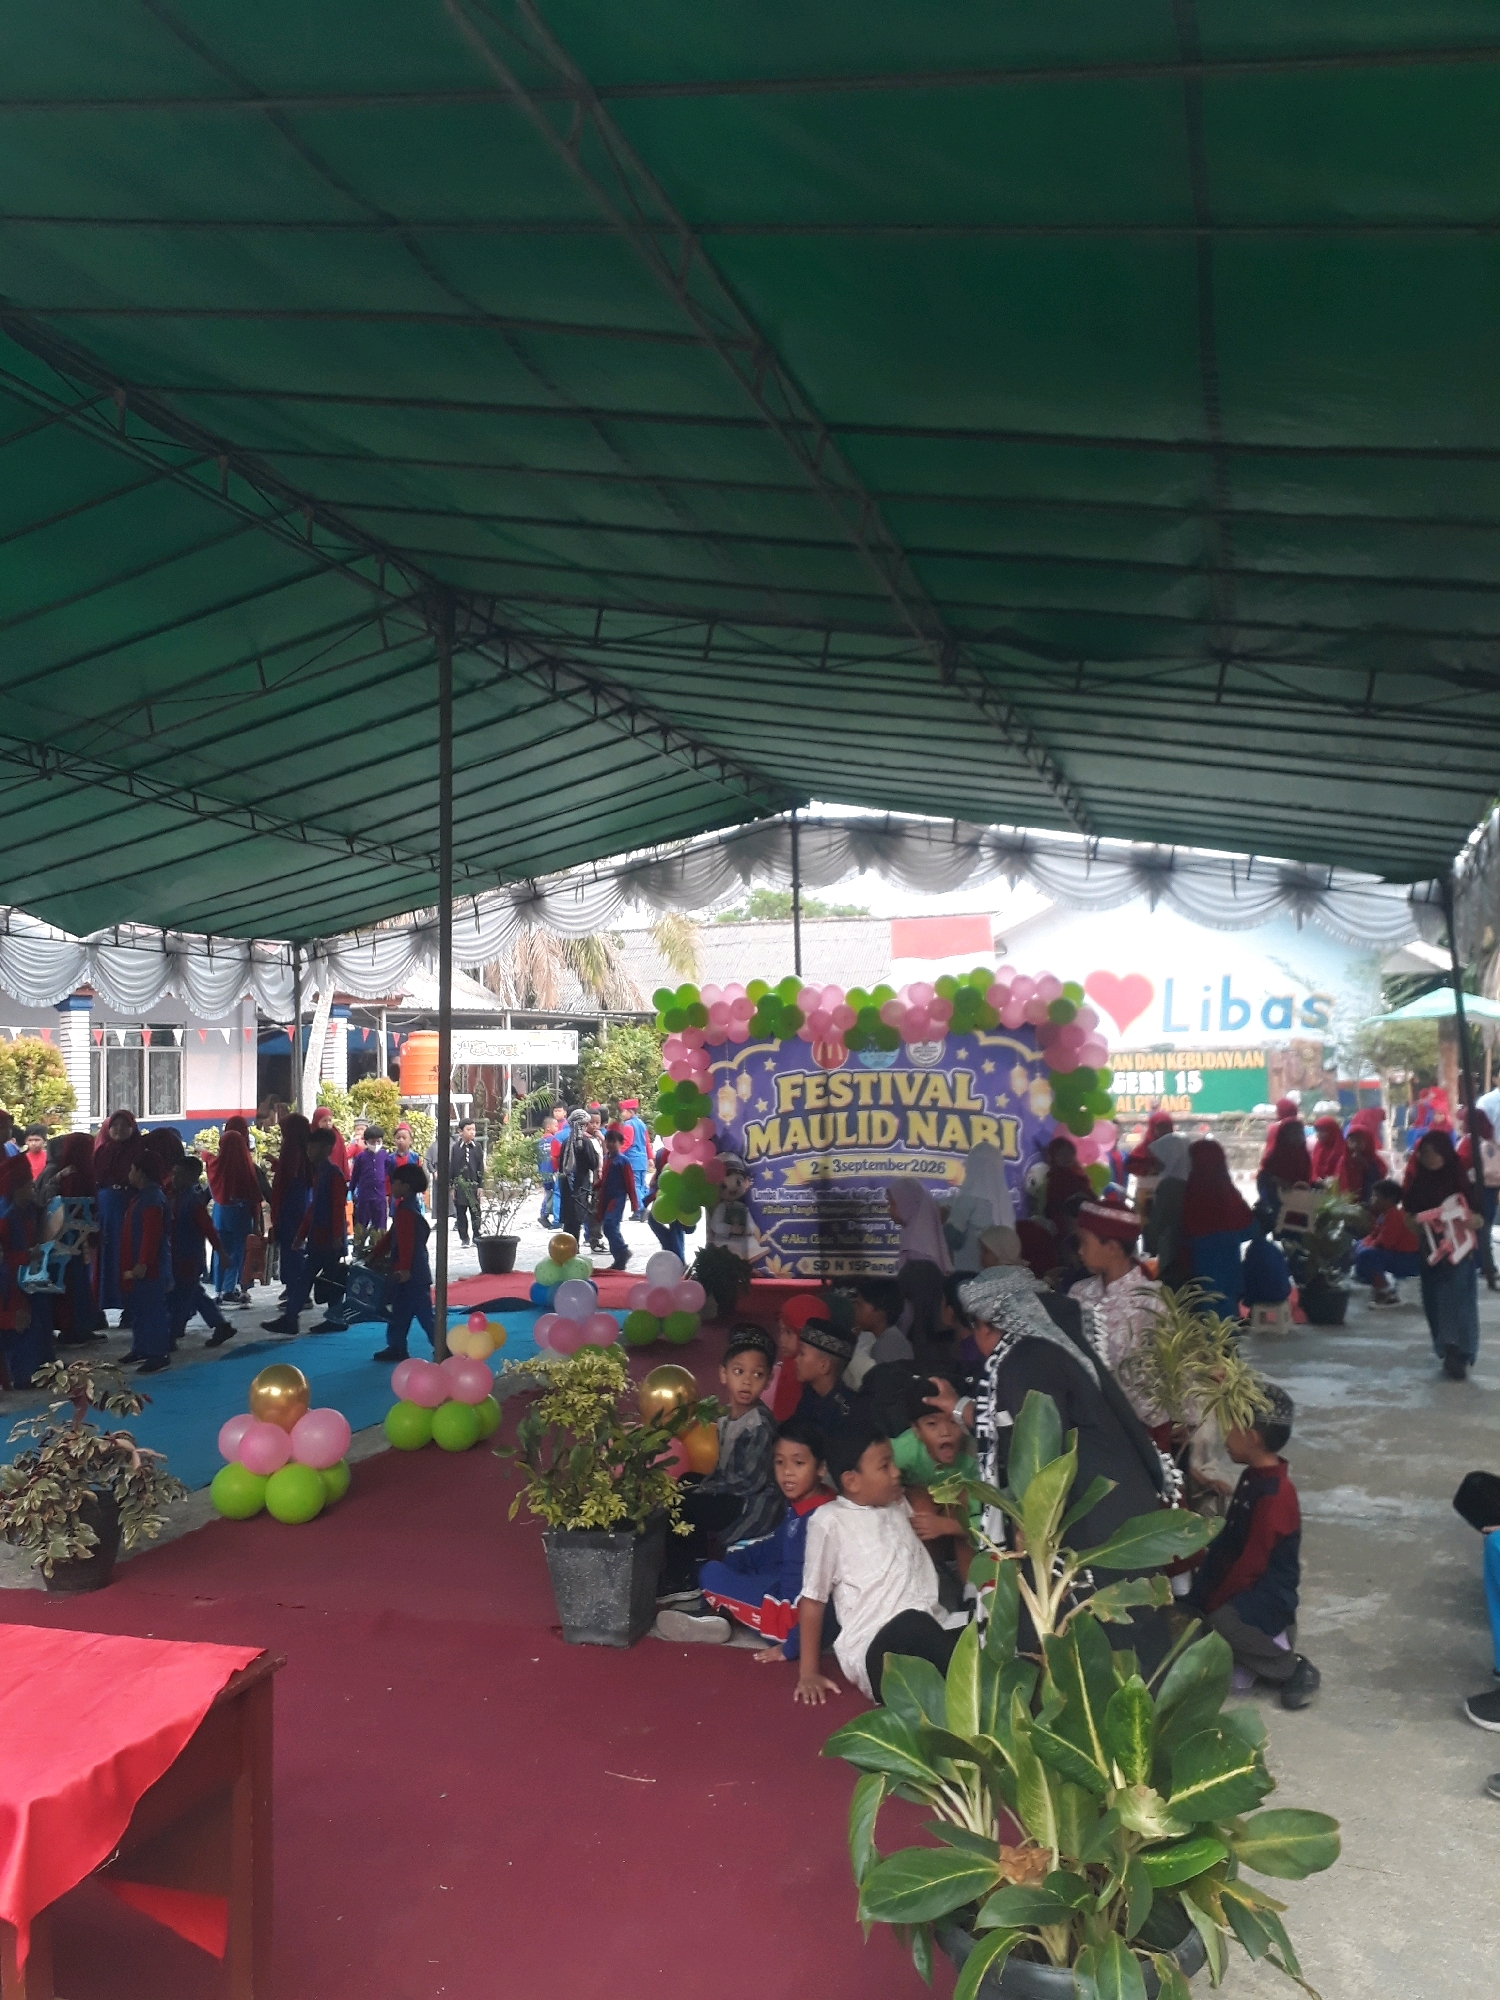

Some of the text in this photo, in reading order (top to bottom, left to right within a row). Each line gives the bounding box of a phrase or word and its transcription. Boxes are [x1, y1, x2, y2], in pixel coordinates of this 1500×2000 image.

[1163, 973, 1334, 1032] Libas
[1135, 1052, 1165, 1071] DAN
[1167, 1051, 1265, 1070] KEBUDAYAAN
[777, 1072, 983, 1113] FESTIVAL
[1107, 1070, 1203, 1094] GERI 15
[747, 1109, 1019, 1159] MAULID NABI
[809, 1162, 821, 1175] 2
[813, 1260, 831, 1271] SD
[835, 1260, 844, 1270] N
